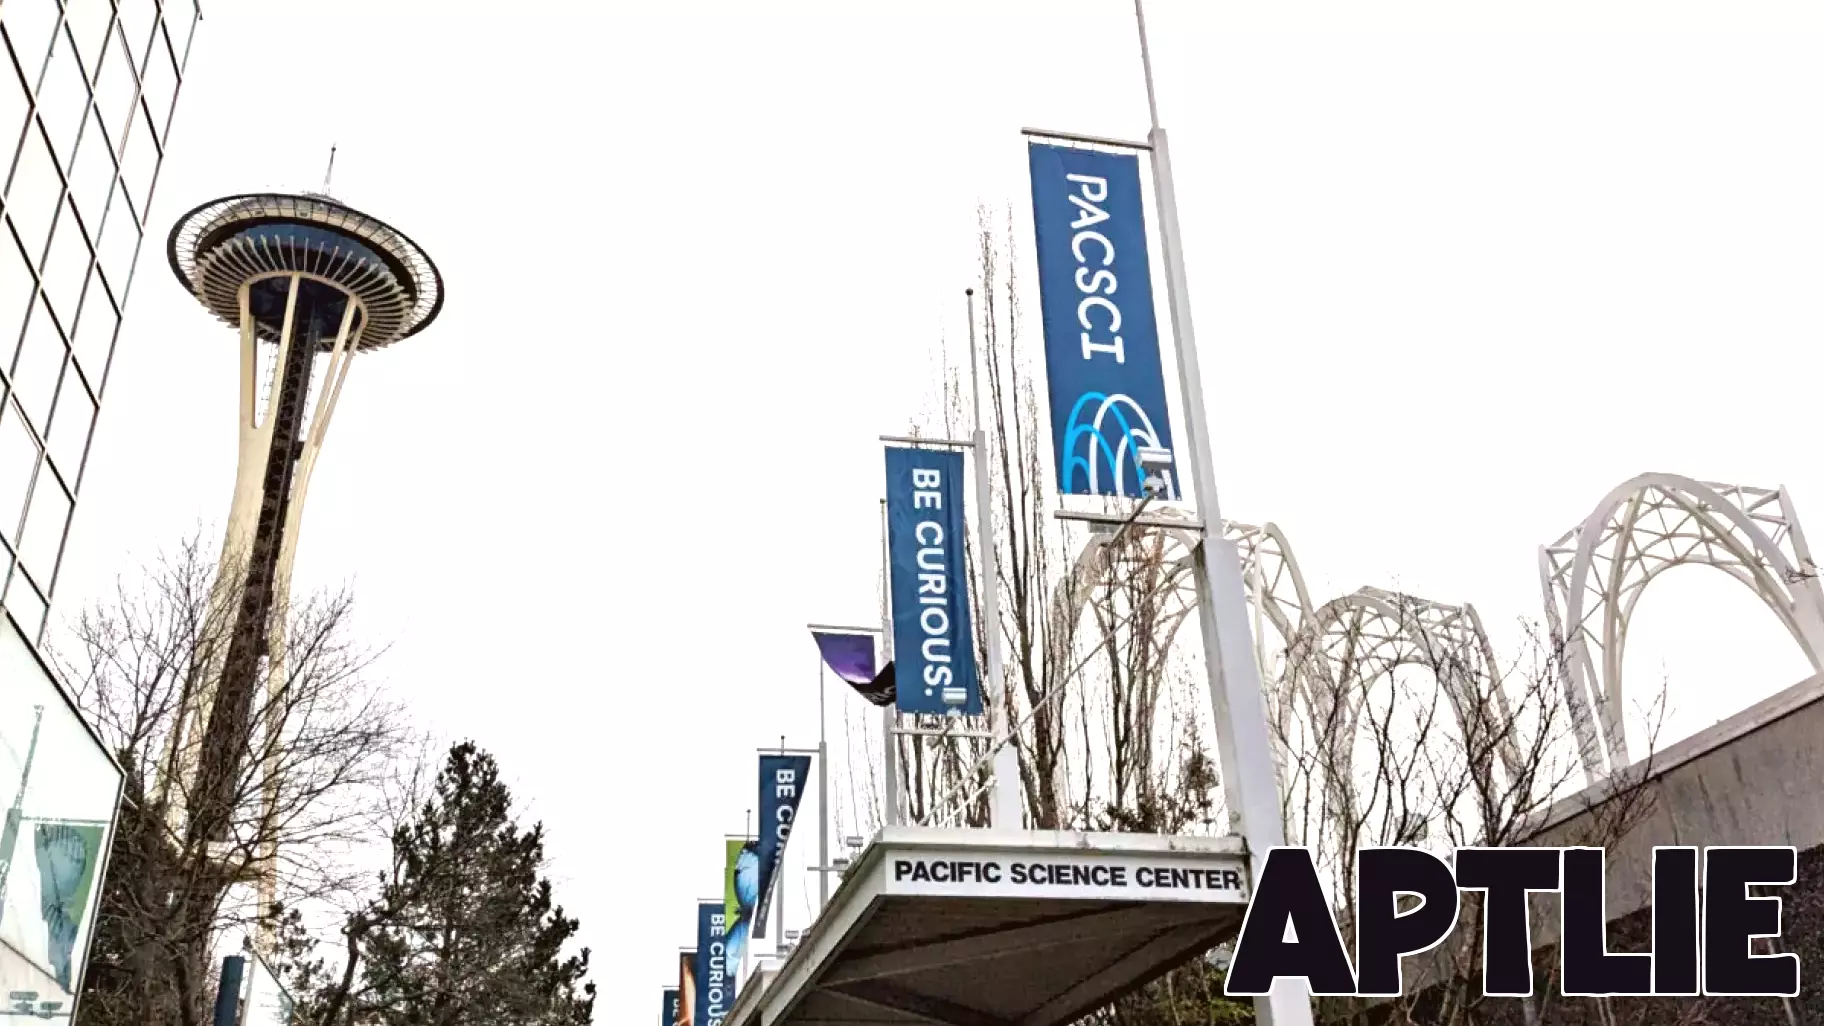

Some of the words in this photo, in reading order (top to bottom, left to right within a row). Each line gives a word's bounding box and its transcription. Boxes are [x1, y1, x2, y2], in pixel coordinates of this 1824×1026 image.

[1066, 172, 1125, 364] PACSCI
[911, 468, 942, 509] BE
[915, 520, 954, 697] CURIOUS.
[776, 768, 796, 799] BE
[894, 860, 1001, 884] PACIFIC
[1010, 863, 1128, 887] SCIENCE
[1135, 868, 1242, 891] CENTER
[710, 913, 726, 937] BE
